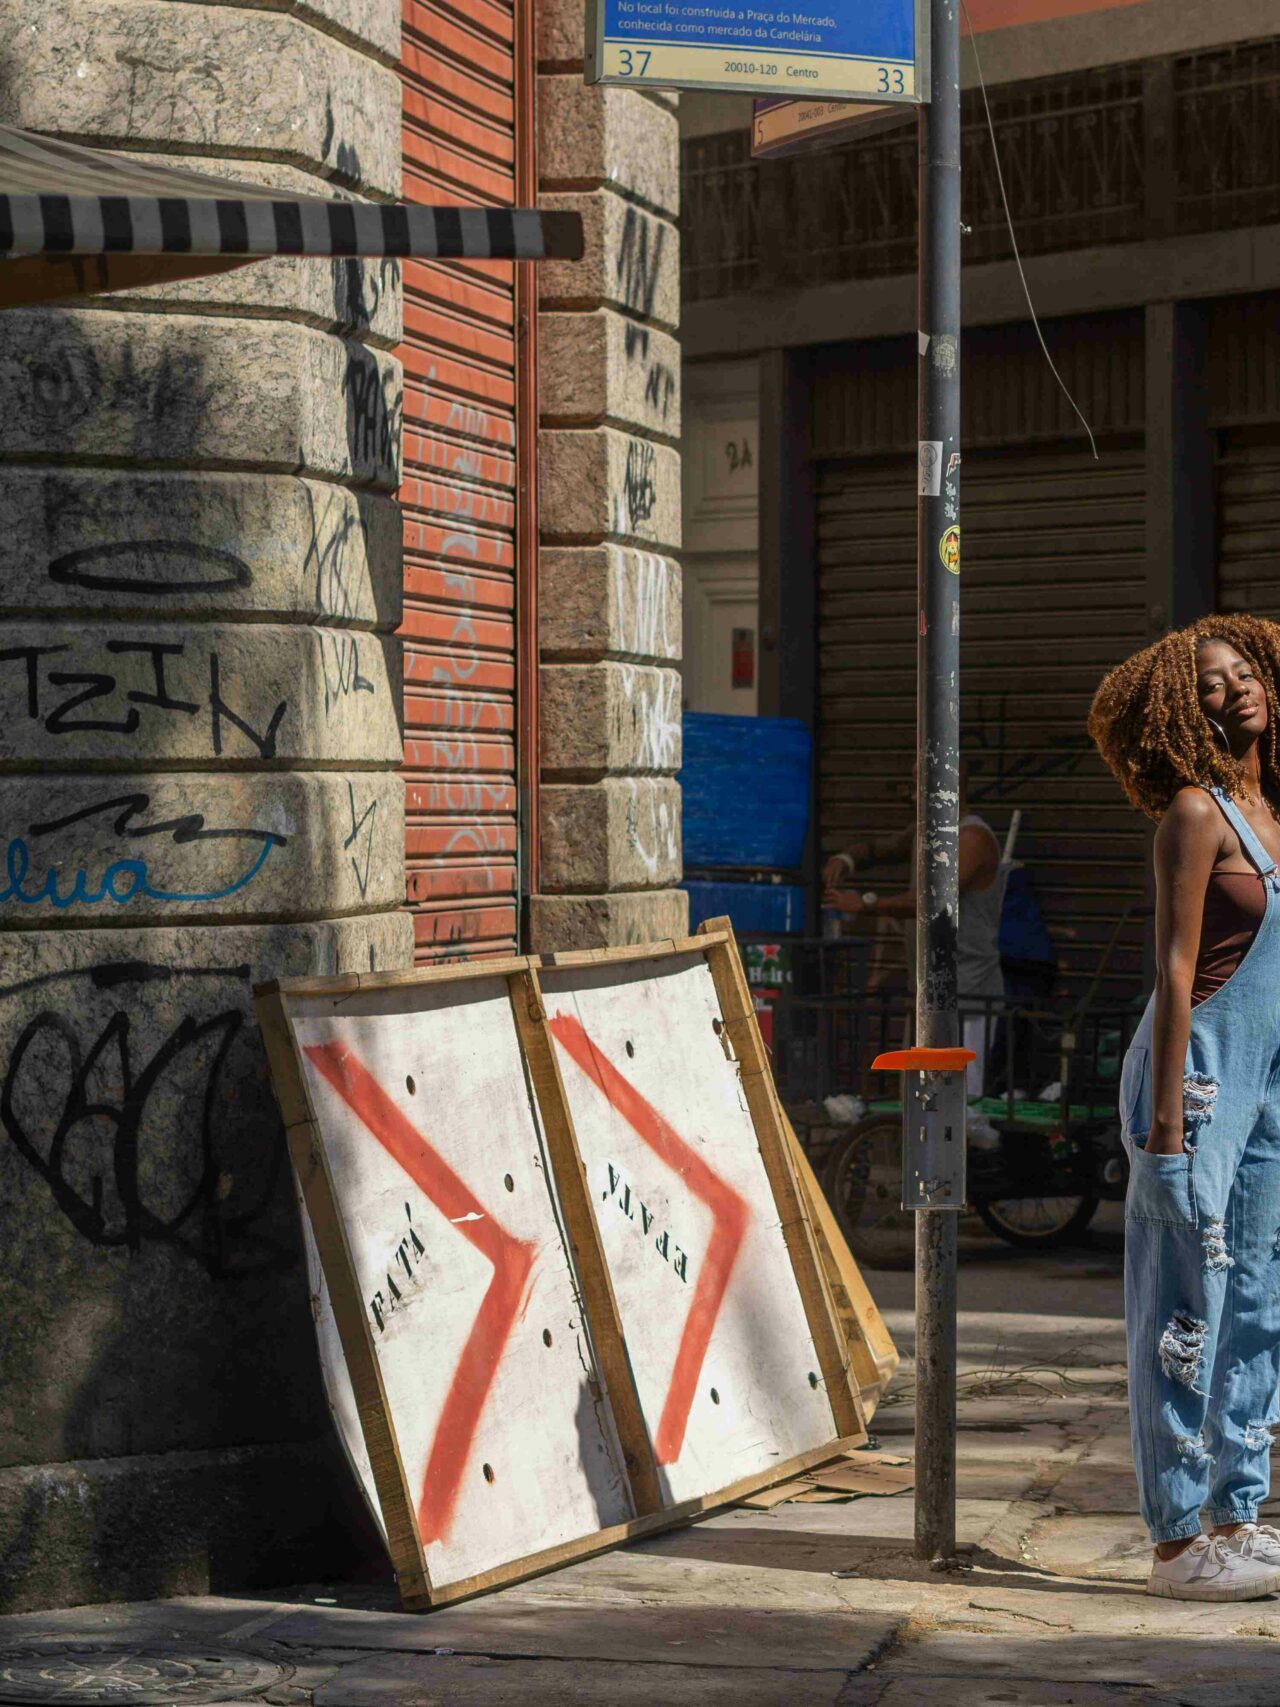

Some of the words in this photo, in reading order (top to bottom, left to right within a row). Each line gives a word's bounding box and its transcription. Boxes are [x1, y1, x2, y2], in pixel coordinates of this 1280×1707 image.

[618, 1, 634, 12] No
[637, 2, 662, 14] local
[665, 3, 679, 15] foi
[738, 11, 744, 20] a
[747, 9, 774, 24] Praça
[776, 11, 790, 23] do
[793, 13, 837, 28] Mercado,
[618, 19, 672, 32] conhecida
[675, 23, 705, 34] como
[707, 25, 752, 37] mercado
[755, 27, 767, 38] da
[618, 49, 652, 77] 37
[725, 61, 777, 75] 20010-120
[786, 65, 819, 79] Centro
[877, 68, 905, 94] 33
